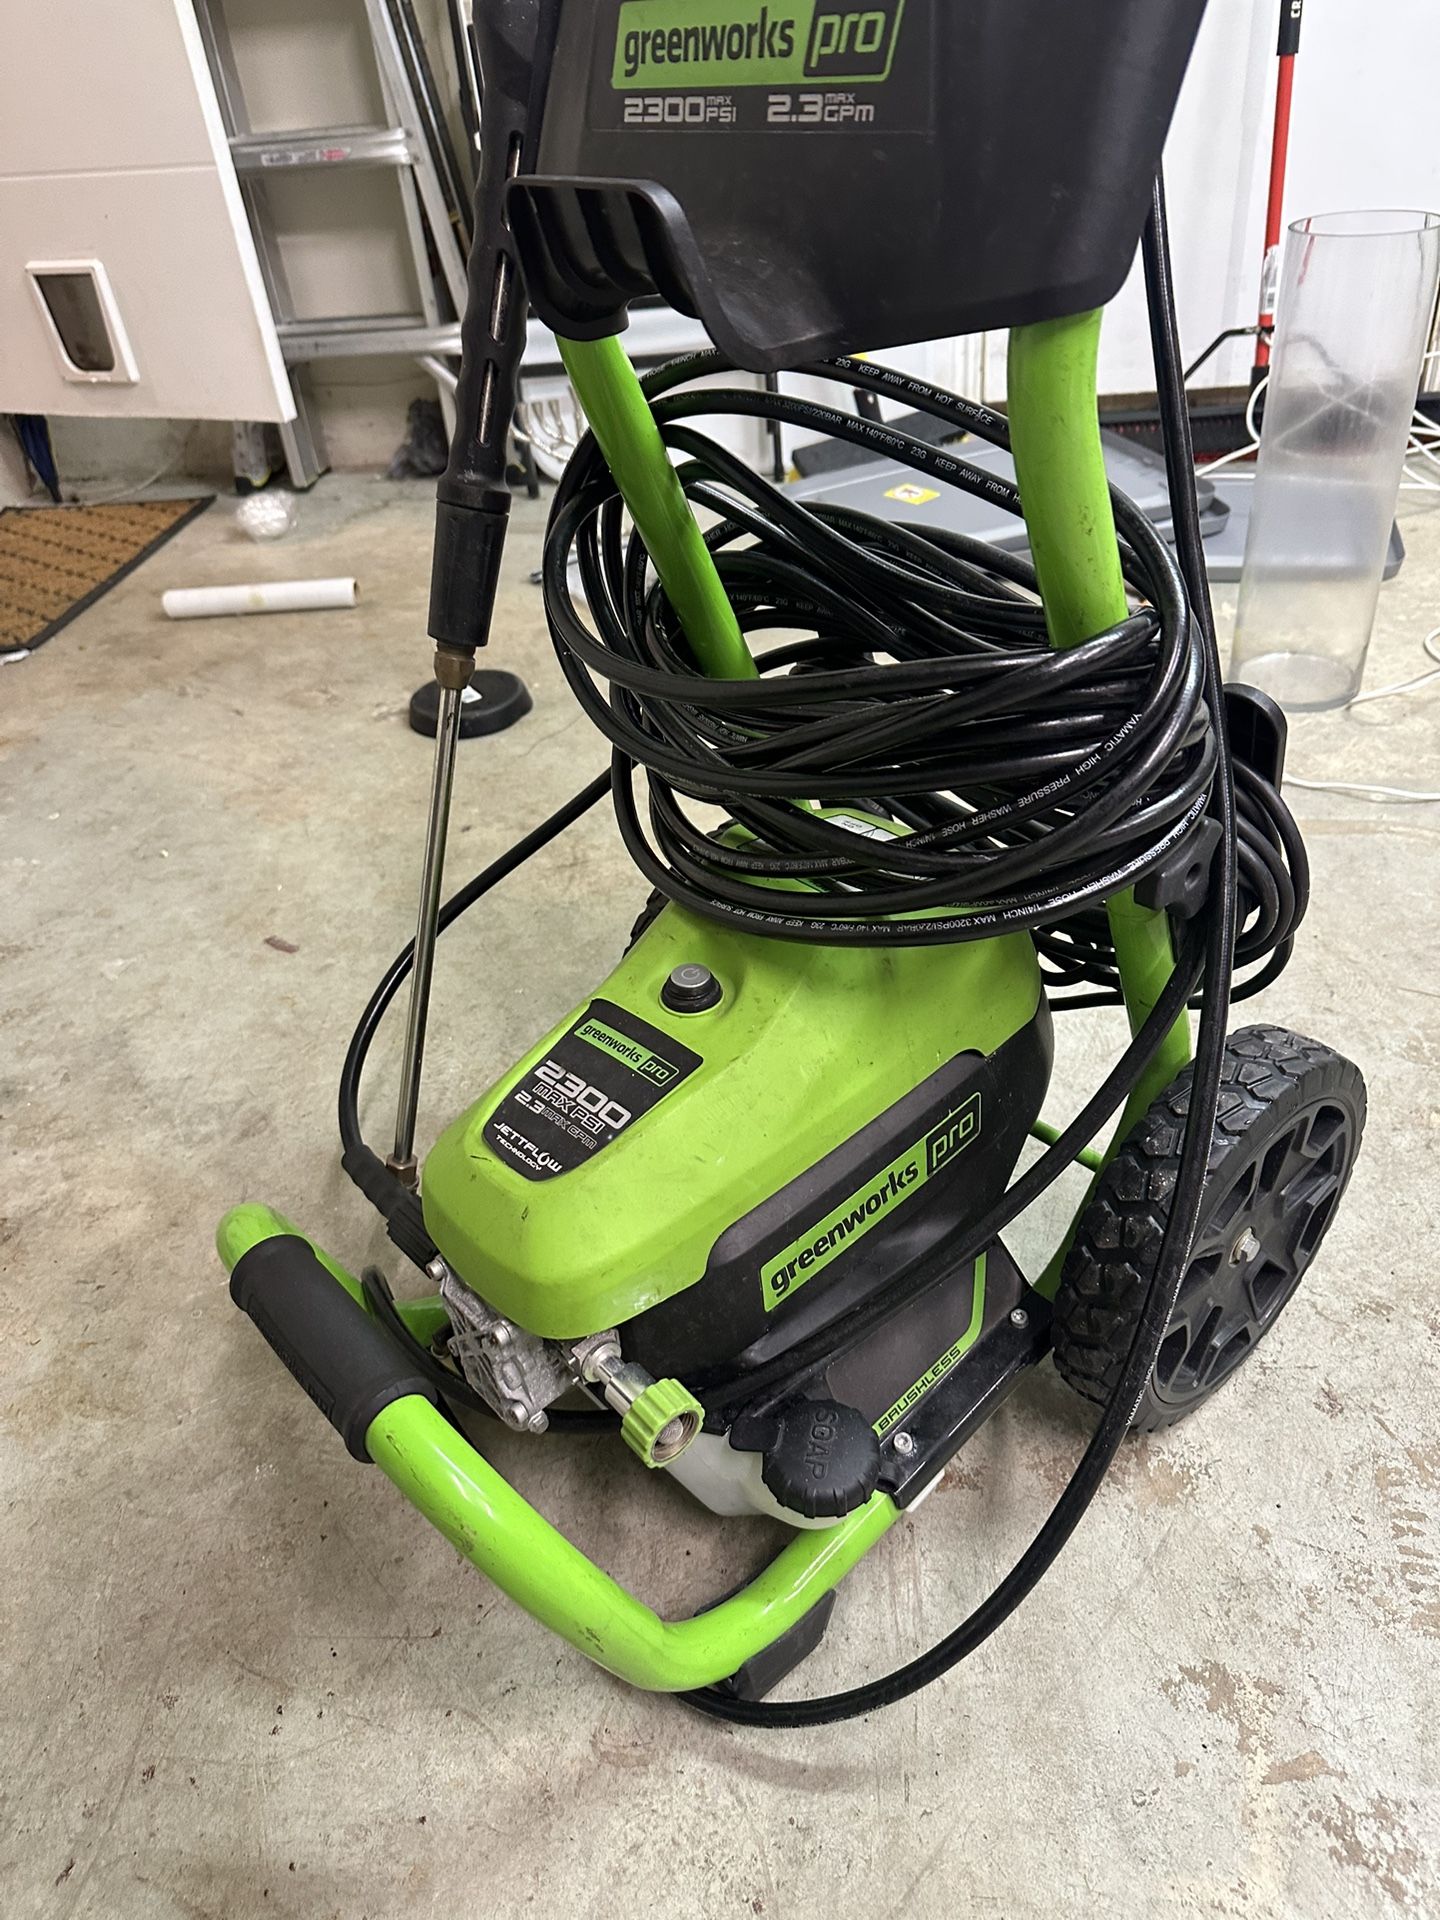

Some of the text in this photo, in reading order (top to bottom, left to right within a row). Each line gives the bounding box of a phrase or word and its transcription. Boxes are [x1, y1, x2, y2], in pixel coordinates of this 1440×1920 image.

[624, 6, 886, 78] greenworks pro
[624, 95, 737, 123] 2300 MAX PSI
[767, 93, 875, 123] 2.3 MAX GPM
[835, 357, 996, 426] 23G KEEP AWAY FROM HOT SURFACE
[846, 419, 865, 433] MAX
[910, 446, 927, 459] 23G
[935, 456, 957, 472] KEEP
[959, 468, 982, 484] AWAY
[986, 480, 1010, 498] FROM
[1104, 713, 1143, 752] YAMATIC
[1075, 753, 1101, 776] HIGH
[1017, 774, 1071, 808] PRESSURE
[971, 803, 1013, 826] WASHER
[1188, 792, 1207, 820] YAMATIC
[942, 821, 967, 837] HOSE
[1172, 816, 1189, 839] HIGH
[1128, 839, 1171, 871] PRESSURE
[1082, 868, 1123, 893] WASHER
[733, 907, 746, 916] HOT
[1003, 903, 1041, 920] 1/4INCH
[1048, 890, 1077, 906] HOSE
[746, 911, 765, 921] FROM
[766, 916, 785, 924] AWAY
[785, 920, 804, 928] KEEP
[811, 921, 826, 930] 23G
[872, 924, 891, 933] MAX
[974, 913, 997, 926] MAX
[581, 1025, 669, 1080] greenworks pro
[532, 1081, 606, 1135] MAX PSI
[534, 1060, 632, 1130] 2300
[514, 1090, 598, 1150] 2.3 MAX GPM
[494, 1122, 563, 1173] JETTFLOW
[495, 1134, 542, 1171] TECHNOLOGY
[771, 1112, 974, 1298] greenworks pro
[878, 1346, 961, 1431] BRUSHLESS
[804, 1406, 839, 1480] SOAP
